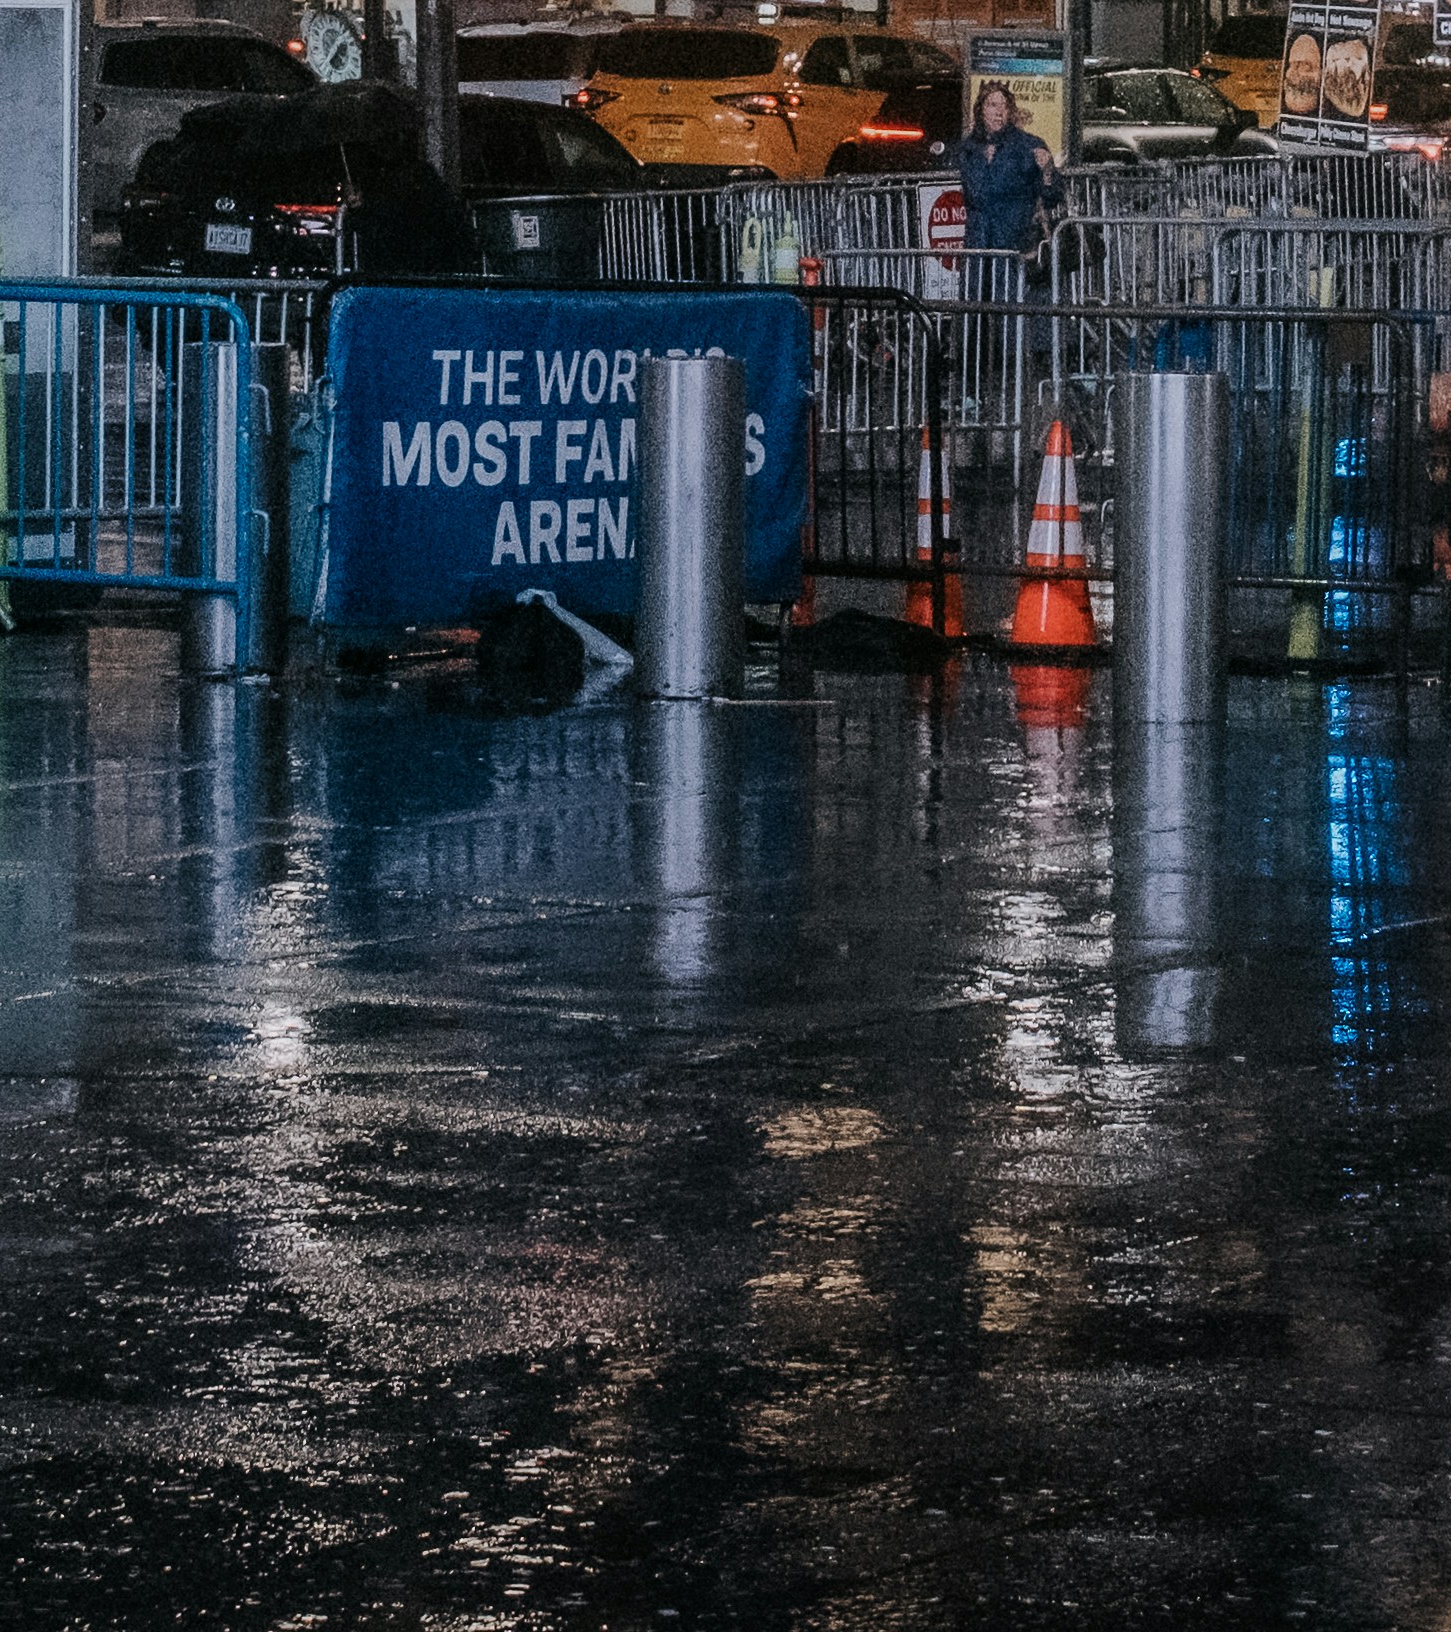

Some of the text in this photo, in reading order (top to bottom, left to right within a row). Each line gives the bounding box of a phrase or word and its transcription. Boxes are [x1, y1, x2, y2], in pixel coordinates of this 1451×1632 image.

[1012, 78, 1058, 93] OFFICIAL
[932, 206, 967, 222] DO NO
[432, 348, 524, 406] THE
[382, 418, 543, 488] MOST
[490, 495, 636, 566] AREN
